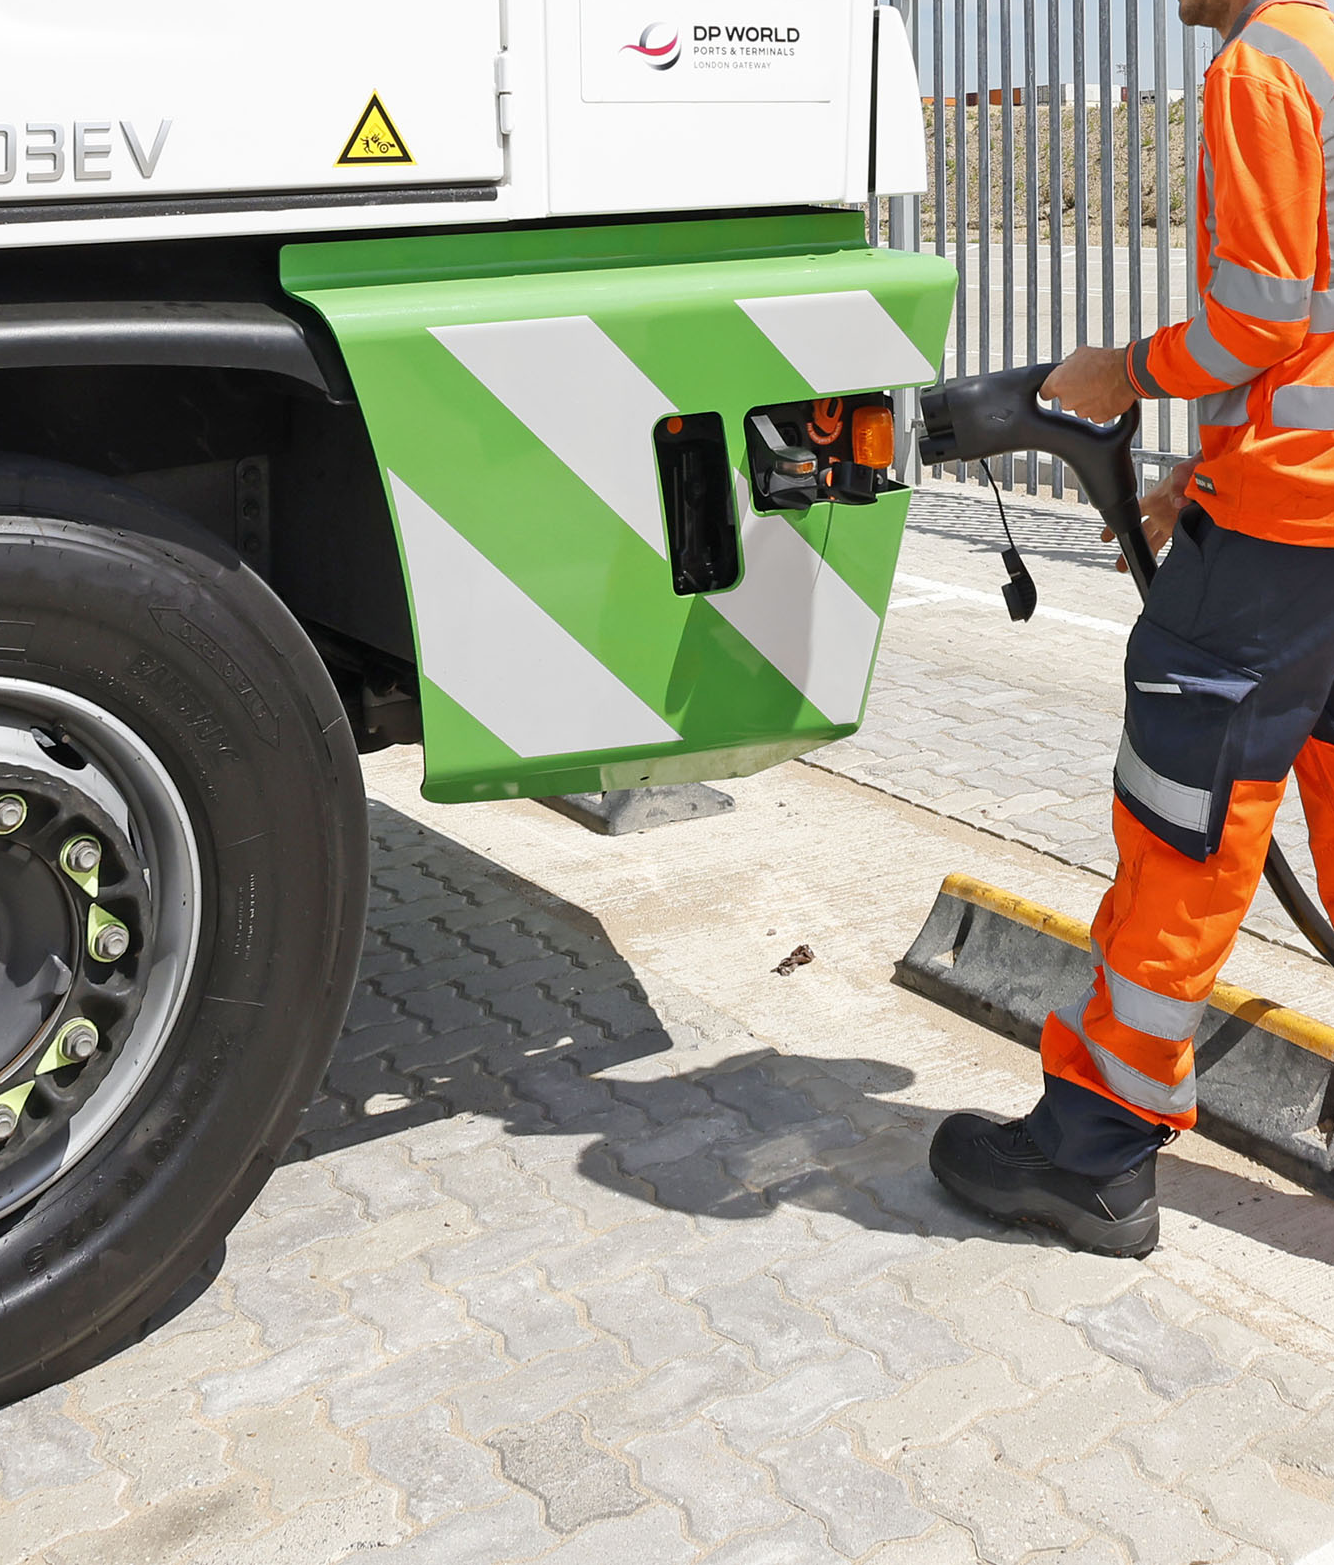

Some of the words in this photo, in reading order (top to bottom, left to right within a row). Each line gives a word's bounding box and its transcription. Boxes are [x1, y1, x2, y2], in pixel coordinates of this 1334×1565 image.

[693, 25, 721, 41] DP
[725, 26, 800, 43] WORLD
[693, 46, 728, 56] PORTS
[730, 46, 737, 56] &
[739, 47, 795, 57] TERMINALS
[693, 60, 731, 70] LONDON
[732, 61, 772, 70] GATEWAY
